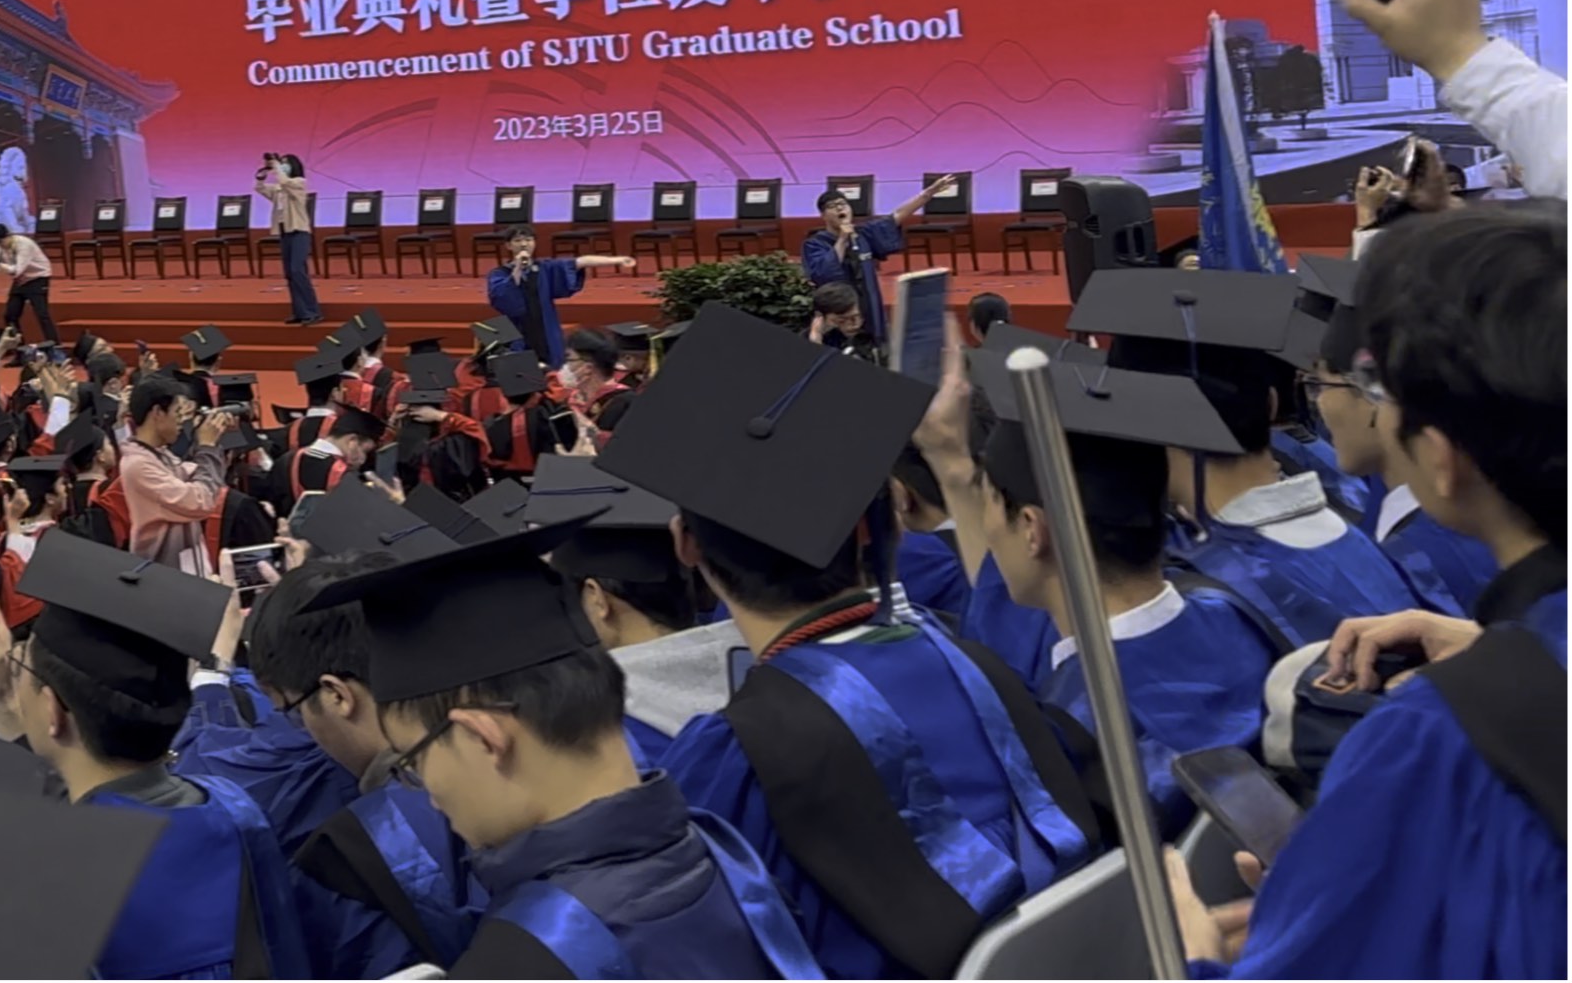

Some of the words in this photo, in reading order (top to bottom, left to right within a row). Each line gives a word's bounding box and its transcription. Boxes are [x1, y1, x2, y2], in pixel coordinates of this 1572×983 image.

[247, 46, 491, 86] Commencement
[500, 42, 535, 69] of
[543, 33, 631, 67] SJTU
[642, 22, 814, 60] Graduate
[825, 8, 963, 47] School
[493, 110, 664, 141] 2023年3月25日
